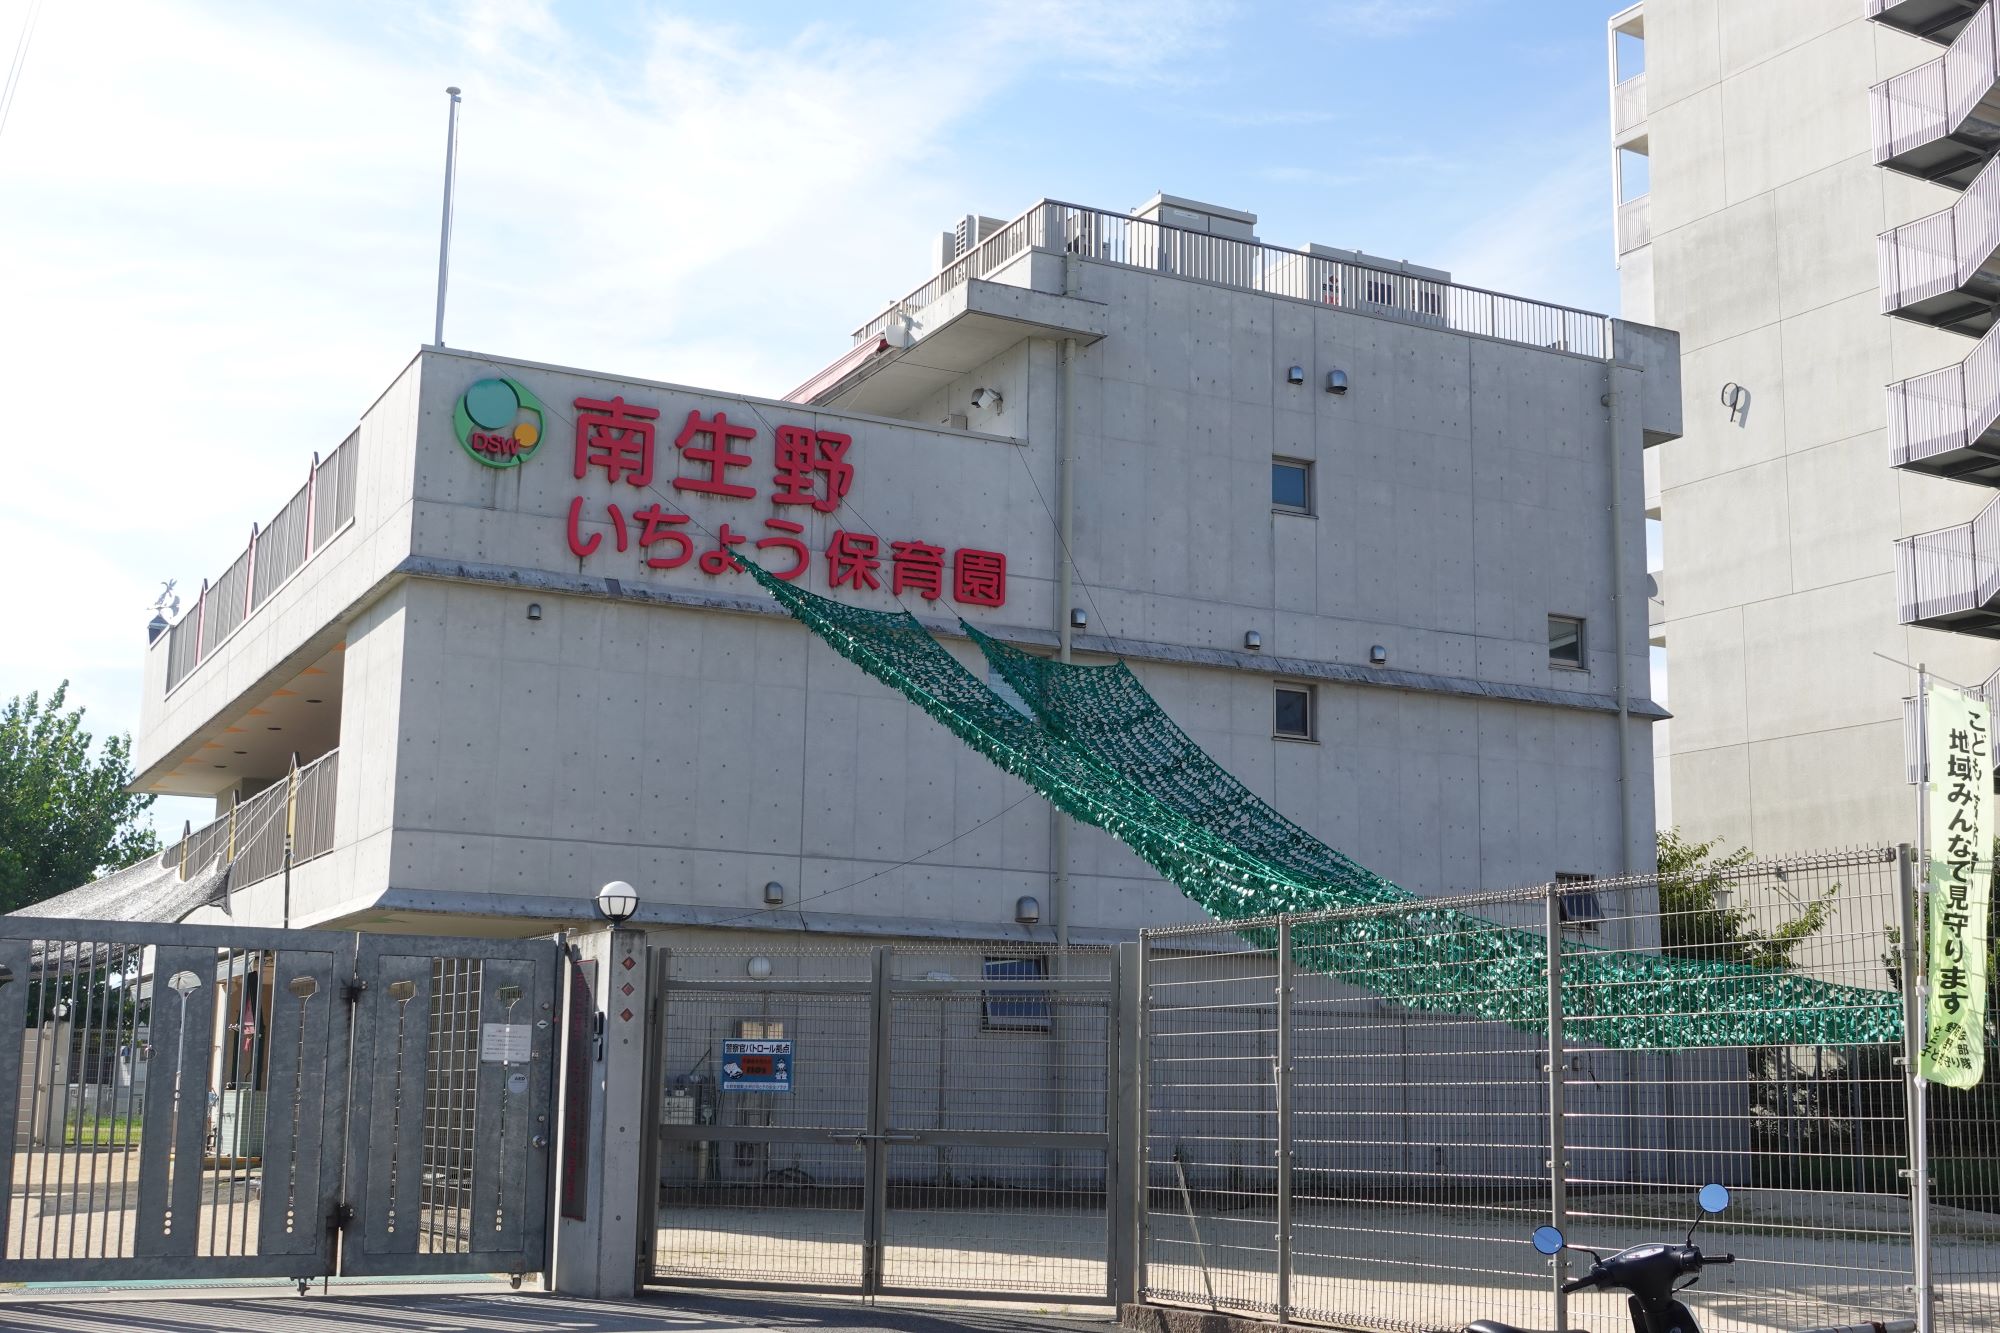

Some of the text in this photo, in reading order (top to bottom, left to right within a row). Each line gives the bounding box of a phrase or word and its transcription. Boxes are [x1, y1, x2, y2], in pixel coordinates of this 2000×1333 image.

[472, 432, 521, 456] DSW
[573, 396, 855, 513] 南生野
[567, 496, 1006, 607] いちょう保育園
[1939, 728, 1973, 1015] 地域みんなで見守ります
[725, 1043, 790, 1054] 警察官パトロール拠点
